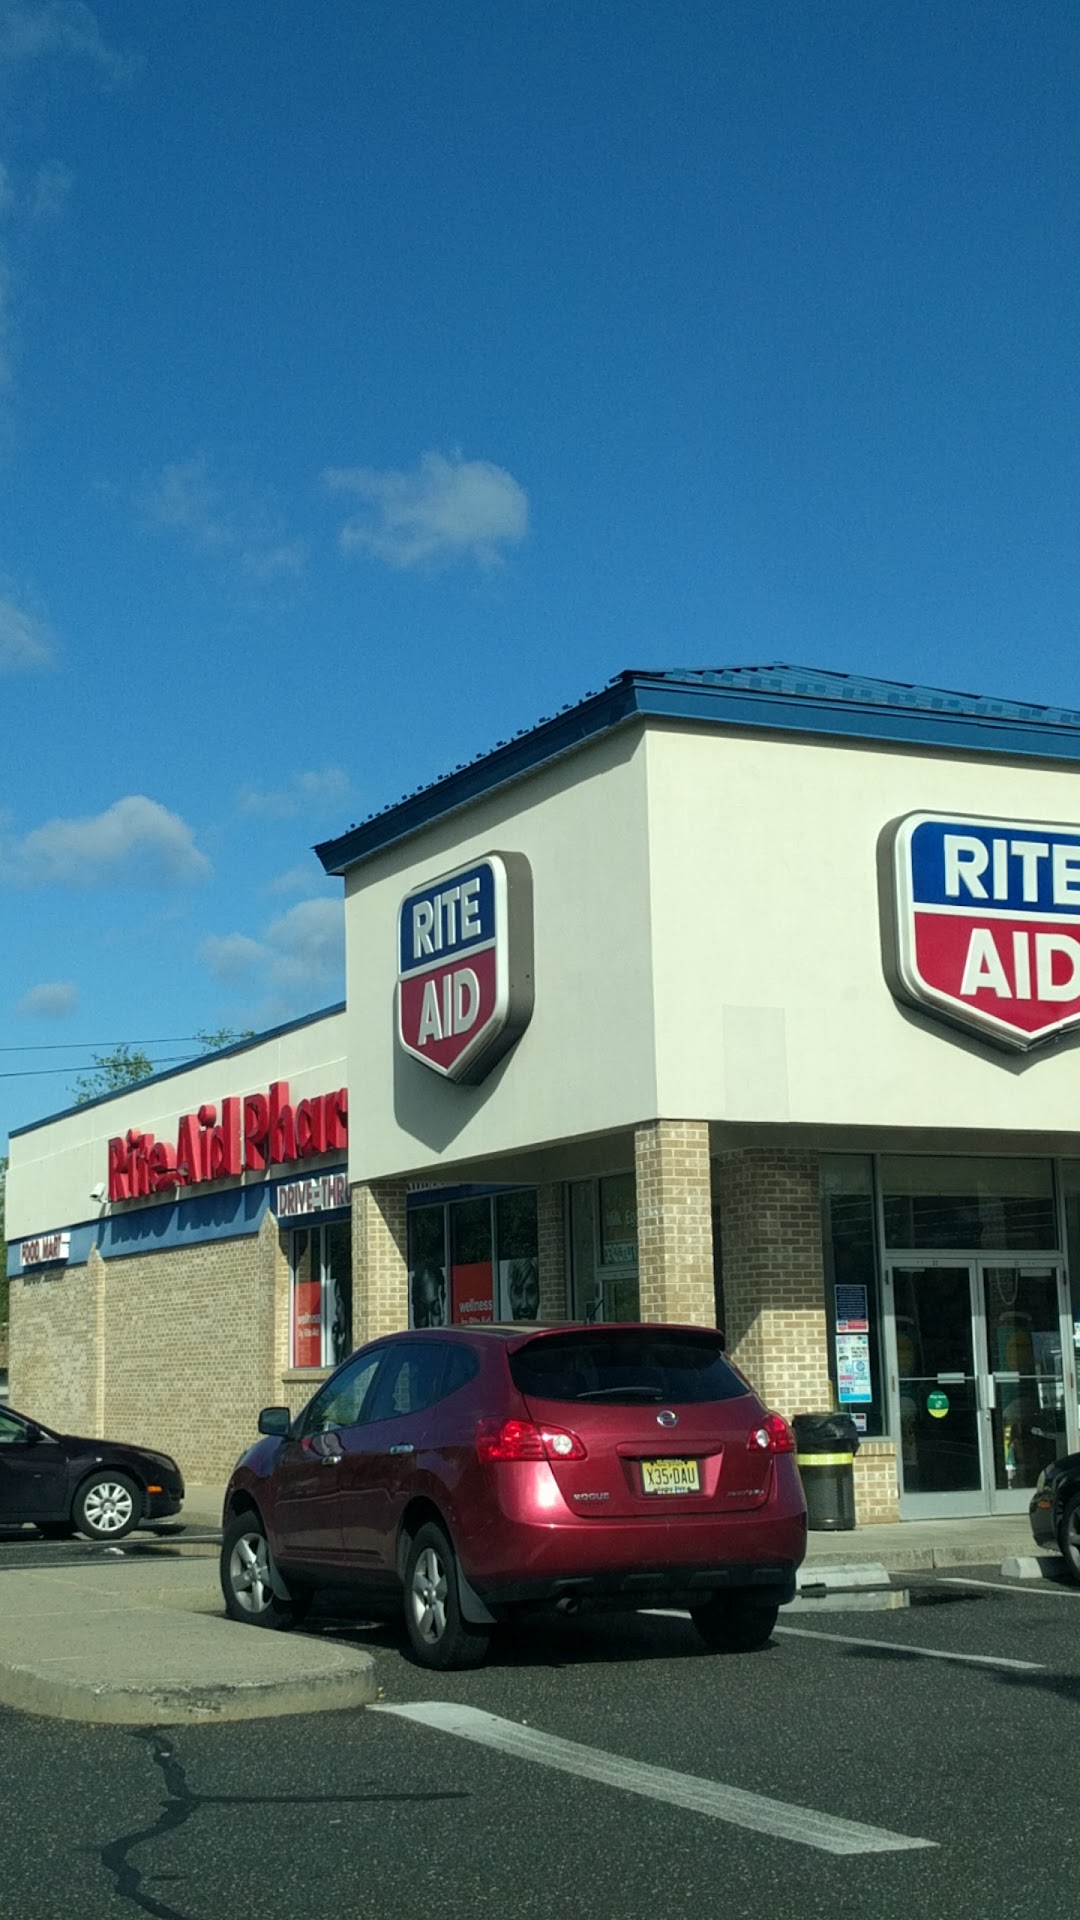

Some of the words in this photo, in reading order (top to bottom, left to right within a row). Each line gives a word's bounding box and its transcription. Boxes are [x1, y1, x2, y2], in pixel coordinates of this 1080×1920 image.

[943, 834, 1080, 906] RITE
[412, 877, 482, 960] RITE
[960, 927, 1080, 1003] AID
[417, 967, 480, 1047] AID
[108, 1128, 187, 1202] Rite
[176, 1096, 242, 1182] Aid
[21, 1239, 40, 1264] FOOD
[42, 1234, 62, 1260] MART
[458, 1297, 494, 1313] wellness
[573, 1491, 610, 1501] ROGUE
